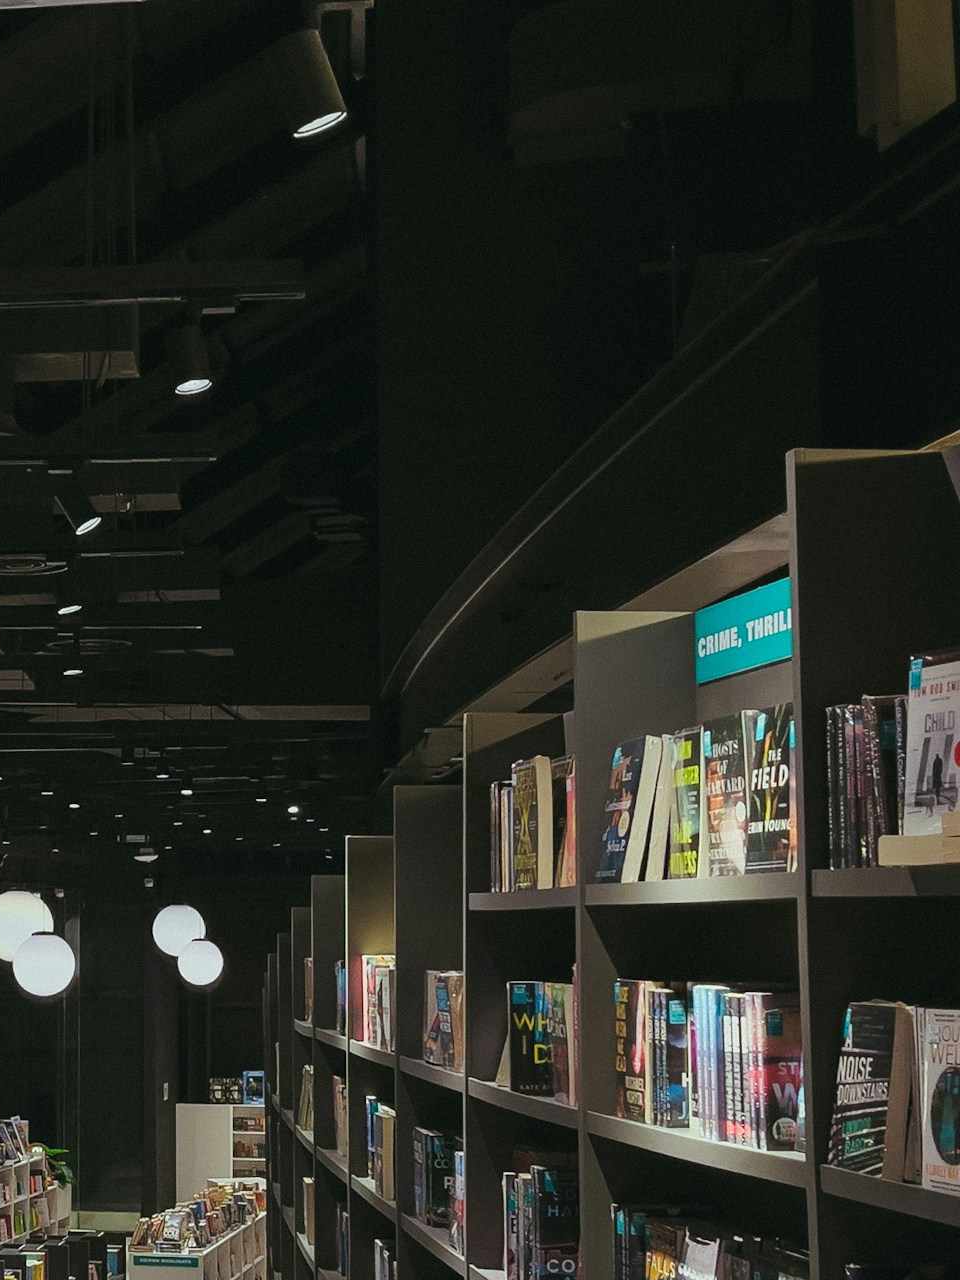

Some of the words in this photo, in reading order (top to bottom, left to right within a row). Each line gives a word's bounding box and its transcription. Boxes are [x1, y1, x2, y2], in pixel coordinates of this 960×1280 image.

[698, 627, 742, 657] CRIME,
[924, 710, 955, 733] CHILD
[709, 739, 739, 759] HOSTS
[751, 764, 789, 791] FIELD
[765, 818, 792, 833] YOUNG
[837, 1055, 874, 1083] NOISE
[837, 1082, 889, 1105] DOWNSTAIRS
[646, 1251, 676, 1279] FALLS
